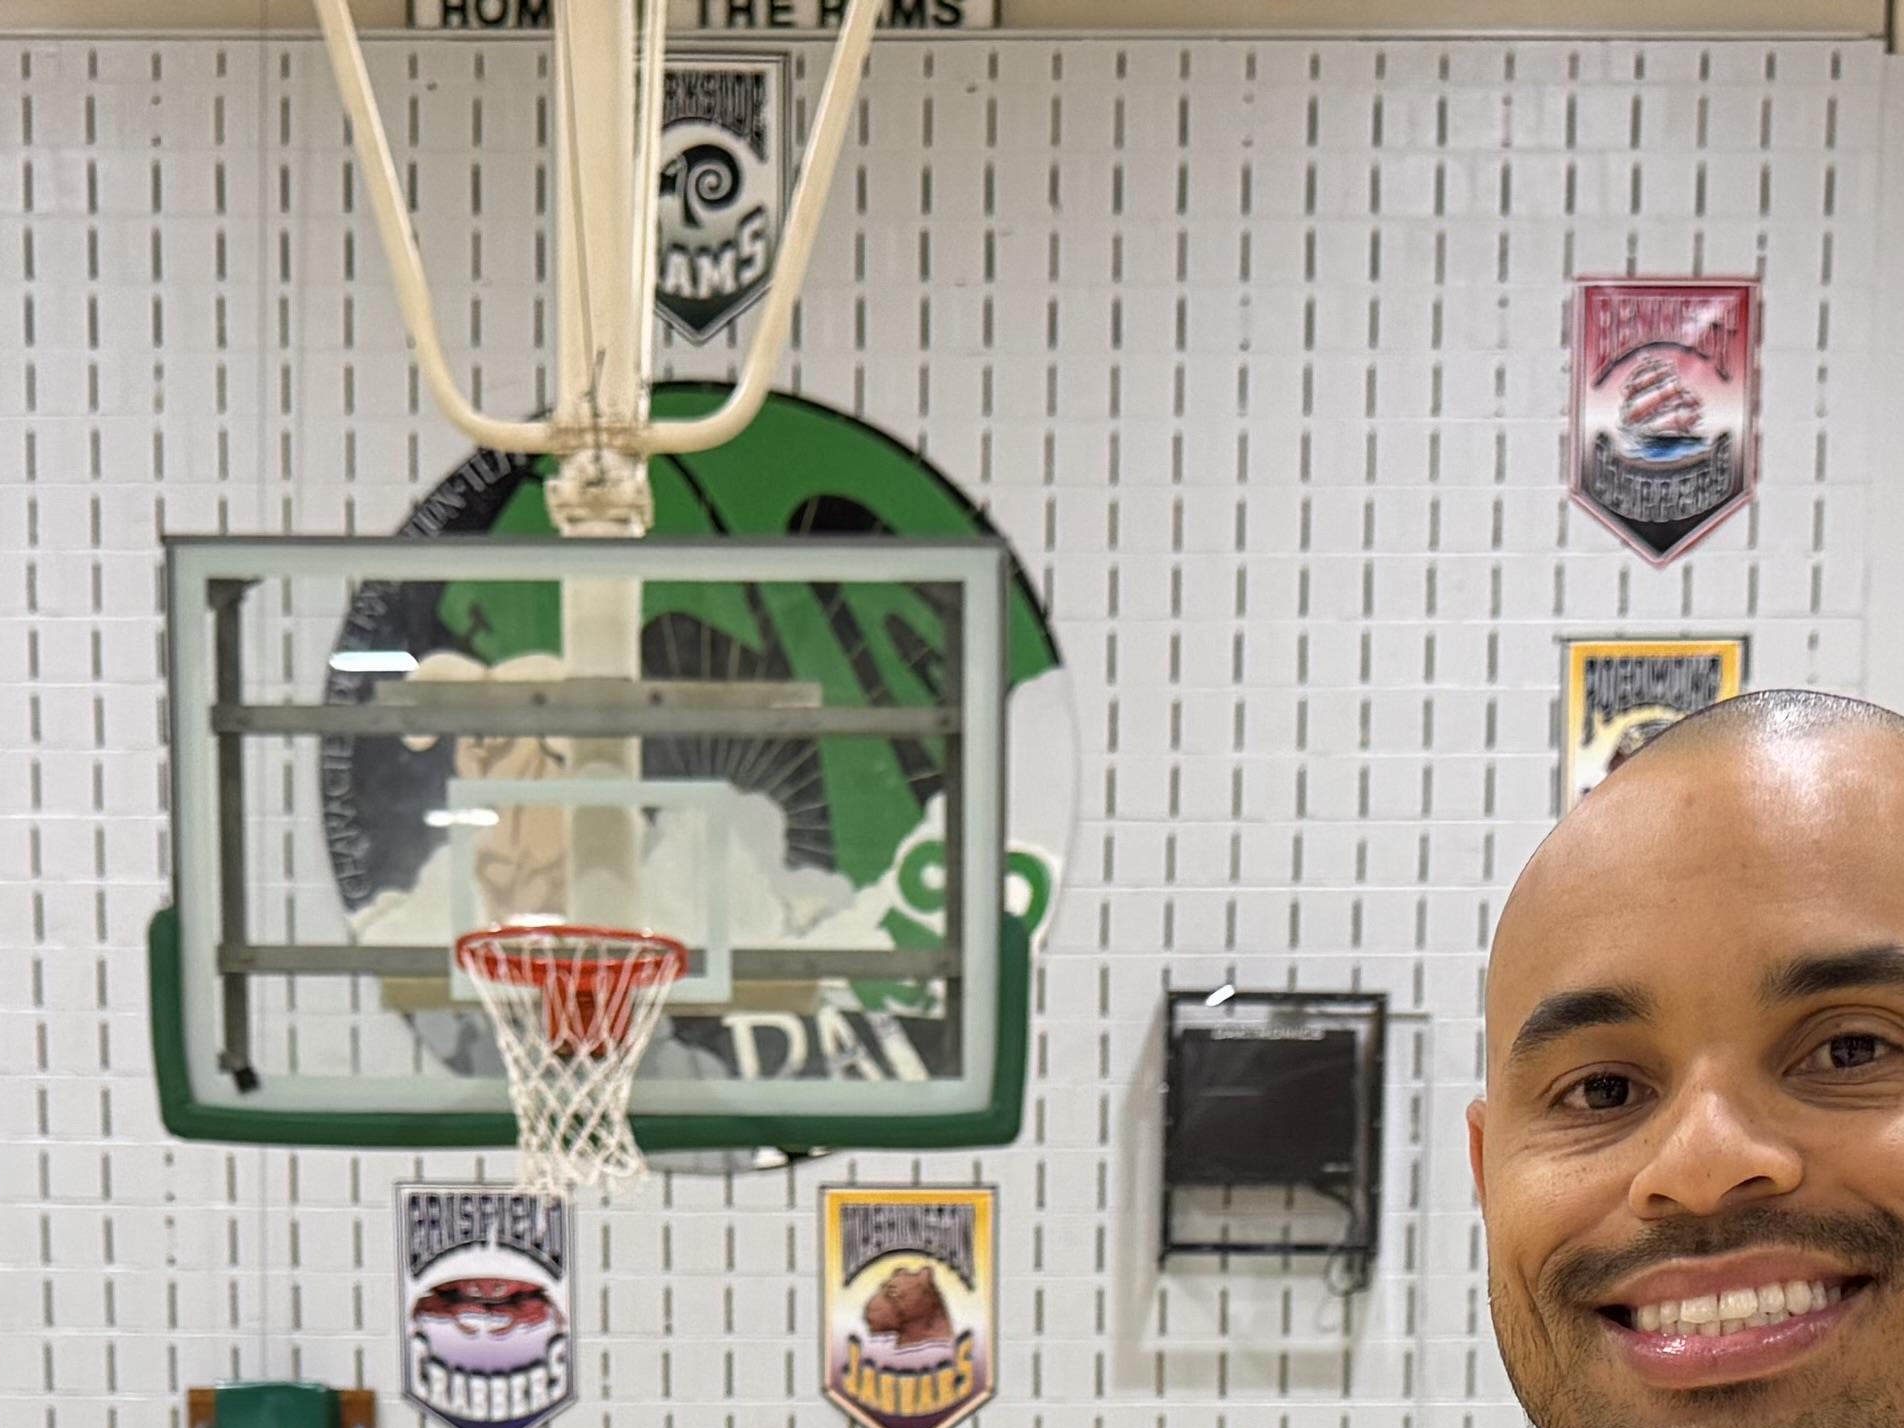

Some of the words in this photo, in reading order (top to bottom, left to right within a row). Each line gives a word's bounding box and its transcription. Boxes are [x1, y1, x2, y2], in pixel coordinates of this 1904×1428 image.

[440, 0, 554, 27] HOM
[693, 0, 795, 27] THE
[659, 205, 768, 299] AMS
